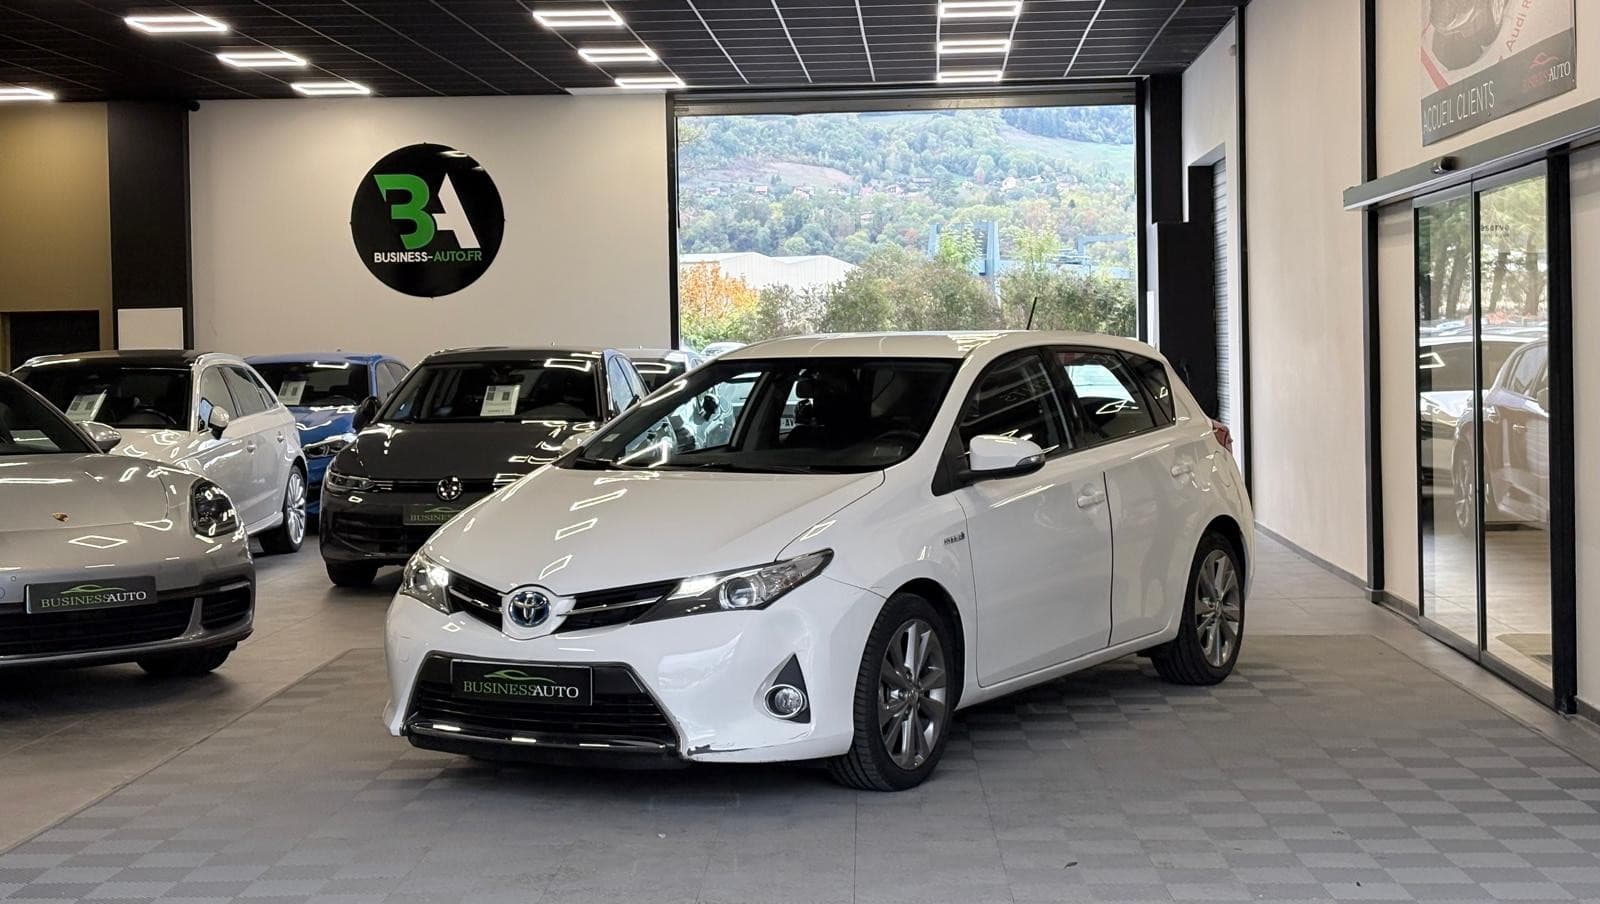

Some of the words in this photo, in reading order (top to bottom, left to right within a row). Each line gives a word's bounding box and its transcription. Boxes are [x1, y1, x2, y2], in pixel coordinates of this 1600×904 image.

[1505, 13, 1527, 52] Audi
[1423, 98, 1454, 134] ACCUEIL
[1456, 80, 1495, 120] CLIENTS
